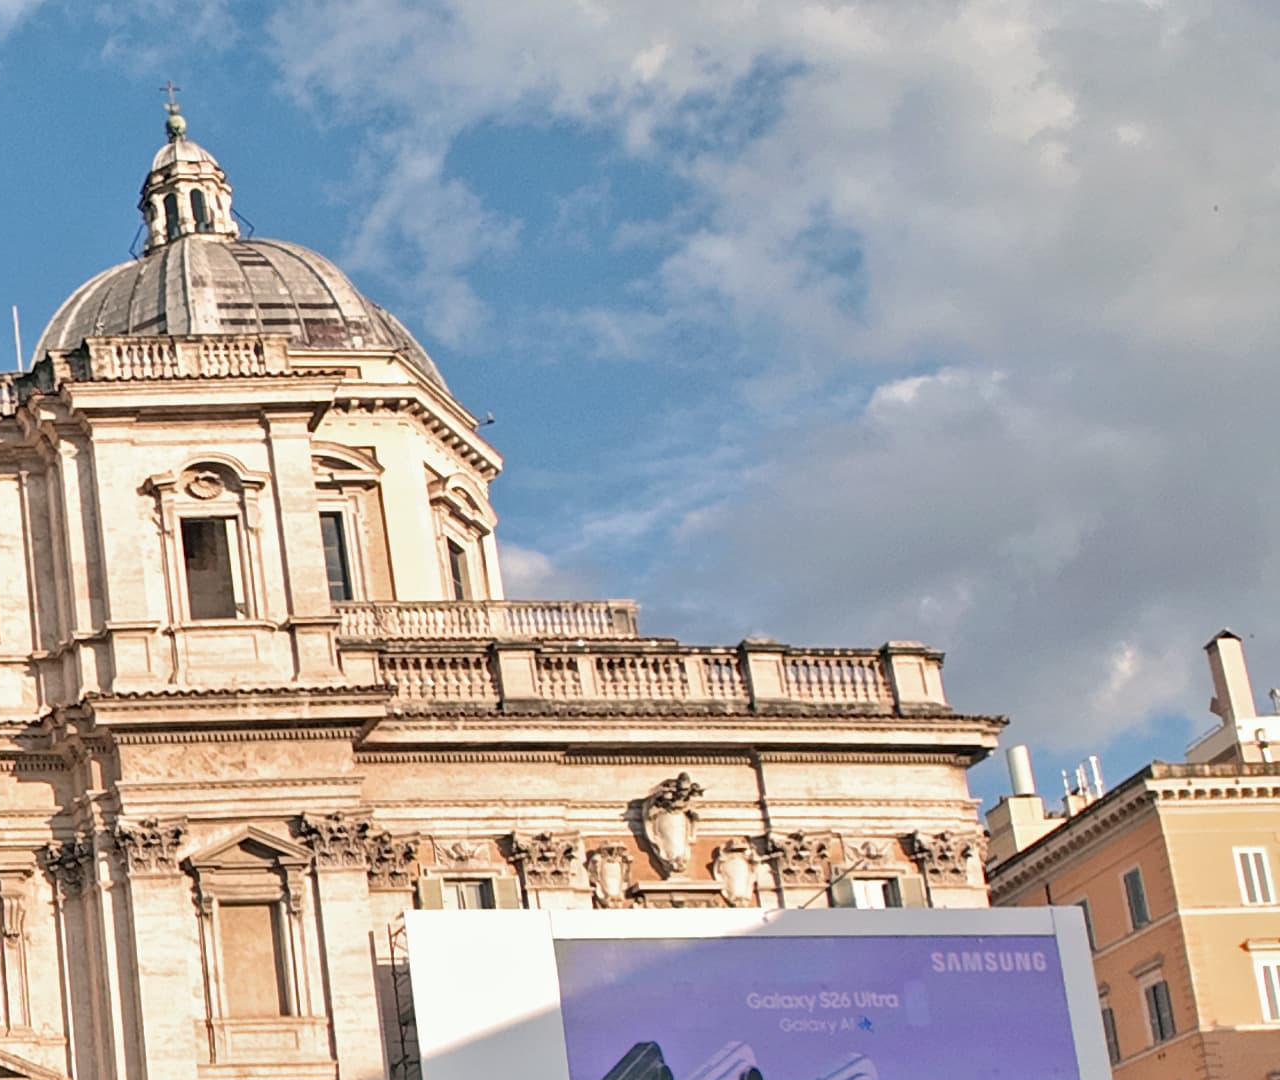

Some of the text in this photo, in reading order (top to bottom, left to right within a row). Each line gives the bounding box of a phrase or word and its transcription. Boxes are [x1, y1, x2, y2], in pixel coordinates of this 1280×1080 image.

[931, 952, 1047, 973] SAMSUNG
[746, 991, 899, 1013] Galaxy S26 Ultra
[779, 1017, 838, 1035] Galaxy
